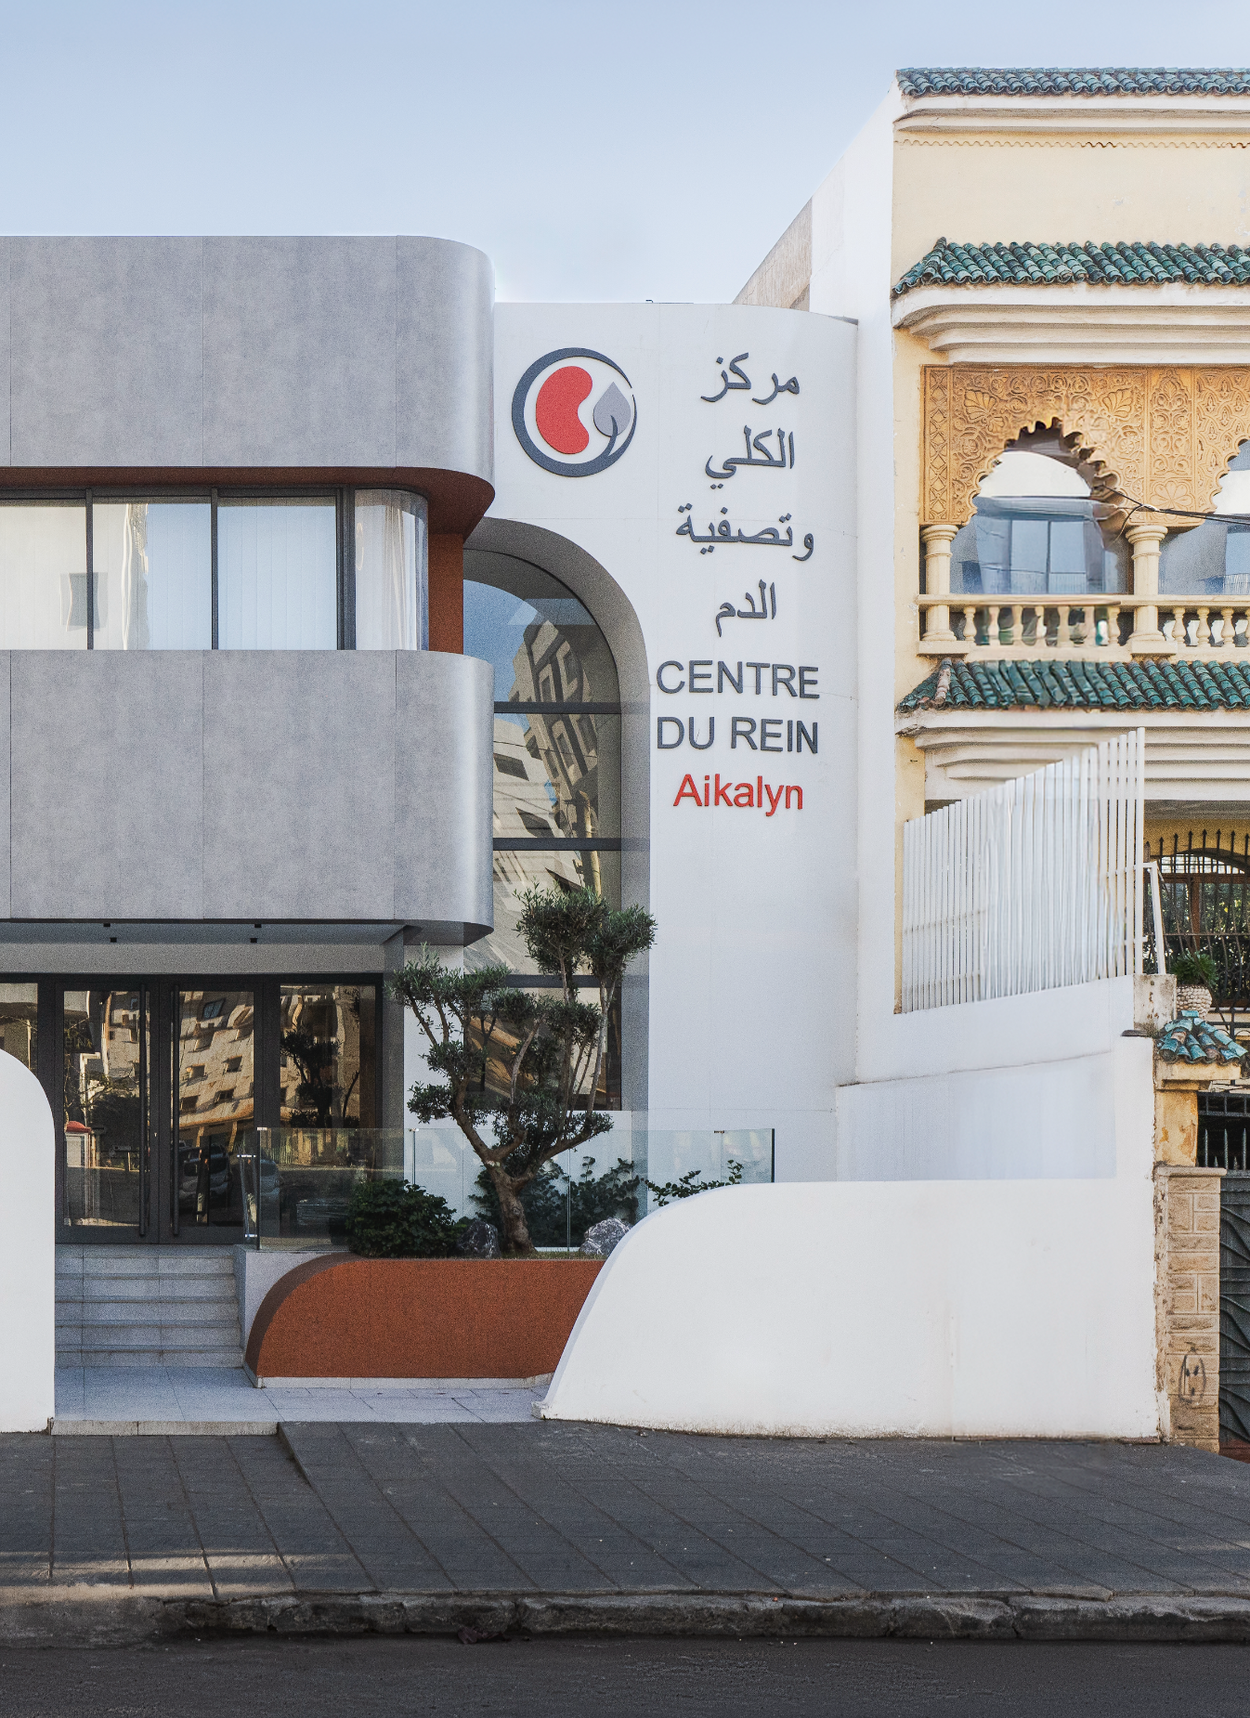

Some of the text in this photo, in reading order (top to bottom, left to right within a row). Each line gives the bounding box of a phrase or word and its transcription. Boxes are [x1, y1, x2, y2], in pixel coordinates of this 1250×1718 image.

[700, 352, 801, 406] مركز
[704, 424, 796, 490] الكلي
[675, 502, 816, 562] وتصفية
[714, 578, 778, 638] الدم
[656, 659, 821, 700] CENTRE
[657, 716, 819, 755] DU REIN
[672, 773, 804, 818] Aikalyn
